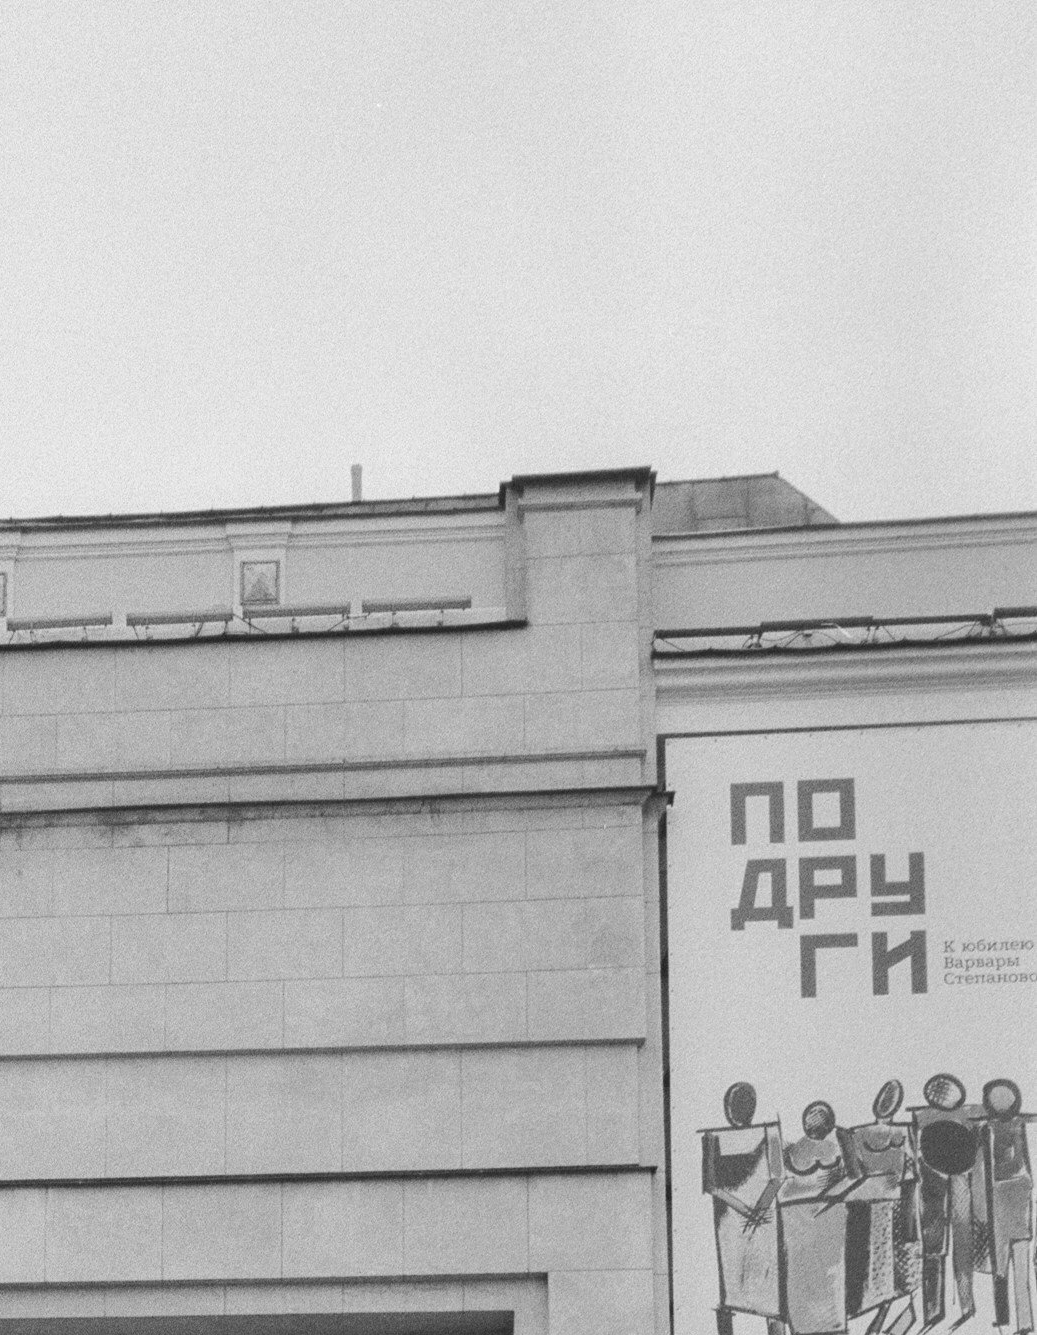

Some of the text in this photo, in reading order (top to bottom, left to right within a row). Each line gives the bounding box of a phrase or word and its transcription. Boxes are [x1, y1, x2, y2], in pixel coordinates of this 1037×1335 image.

[730, 778, 856, 845] ПО
[731, 852, 925, 930] ДРУ
[800, 930, 927, 998] ГИ
[944, 939, 1034, 953] К юбилею
[944, 957, 1019, 972] Варвары
